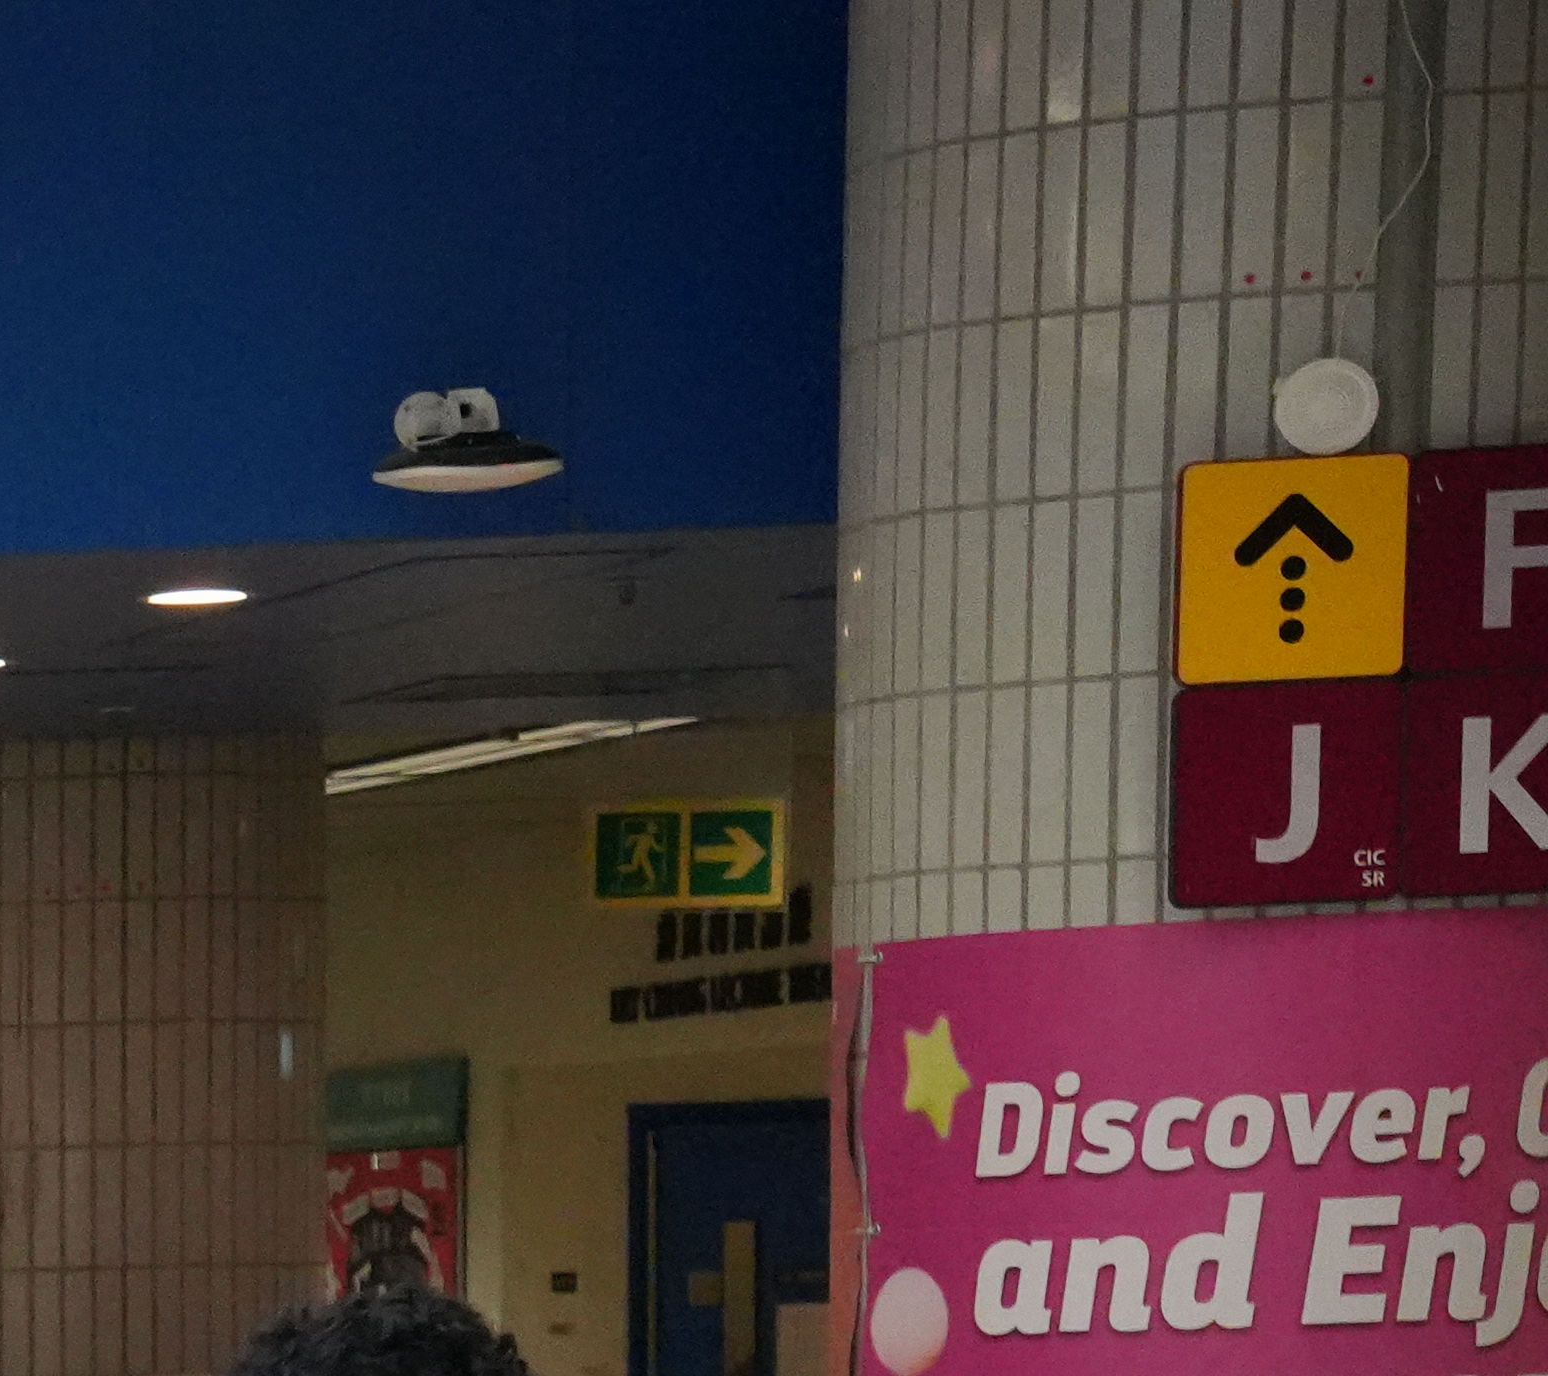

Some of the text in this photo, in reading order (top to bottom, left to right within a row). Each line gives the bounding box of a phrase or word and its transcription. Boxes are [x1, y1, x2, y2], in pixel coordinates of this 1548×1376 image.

[1253, 713, 1548, 864] J K
[1353, 849, 1386, 867] CIC
[1361, 870, 1386, 888] SR
[974, 1071, 1486, 1178] Discover,
[972, 1178, 1548, 1347] and Enj
